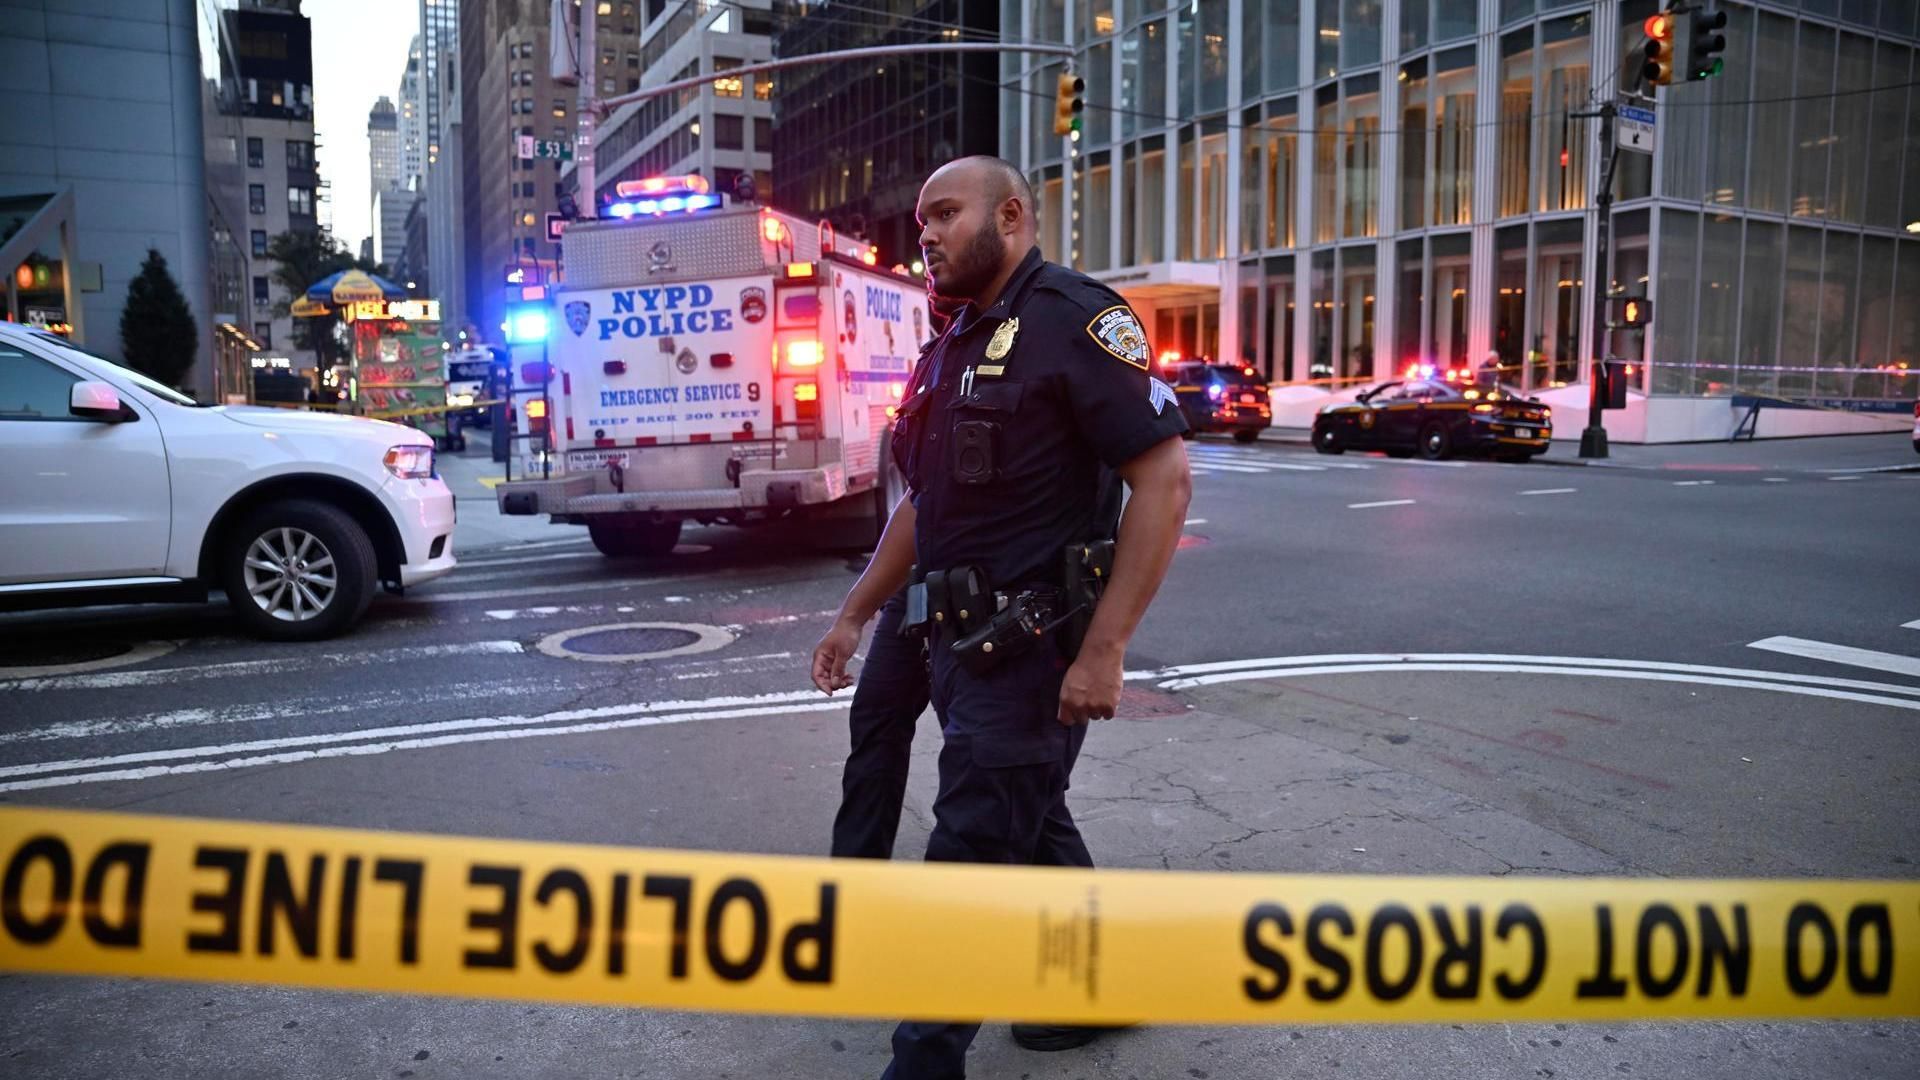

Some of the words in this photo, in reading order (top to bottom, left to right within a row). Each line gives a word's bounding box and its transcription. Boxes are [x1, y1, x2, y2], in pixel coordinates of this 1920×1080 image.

[535, 141, 541, 157] E
[545, 141, 560, 158] 53
[612, 284, 714, 315] NYPD
[866, 285, 902, 322] POLICE
[598, 308, 733, 341] POLICE
[1100, 310, 1123, 326] POLICE
[1108, 343, 1125, 356] CITY
[600, 387, 679, 407] EMERGENCY
[685, 383, 741, 403] SERVICE
[747, 382, 761, 402] 9
[588, 417, 629, 427] KEEP
[636, 414, 677, 424] BACK
[720, 409, 761, 419] FEET
[0, 834, 153, 952] DO
[186, 845, 426, 966] LINE
[463, 865, 837, 985] POLICE
[1242, 904, 1549, 1005] CROSS
[1574, 903, 1754, 1002] NOT
[1781, 900, 1896, 1001] DO
